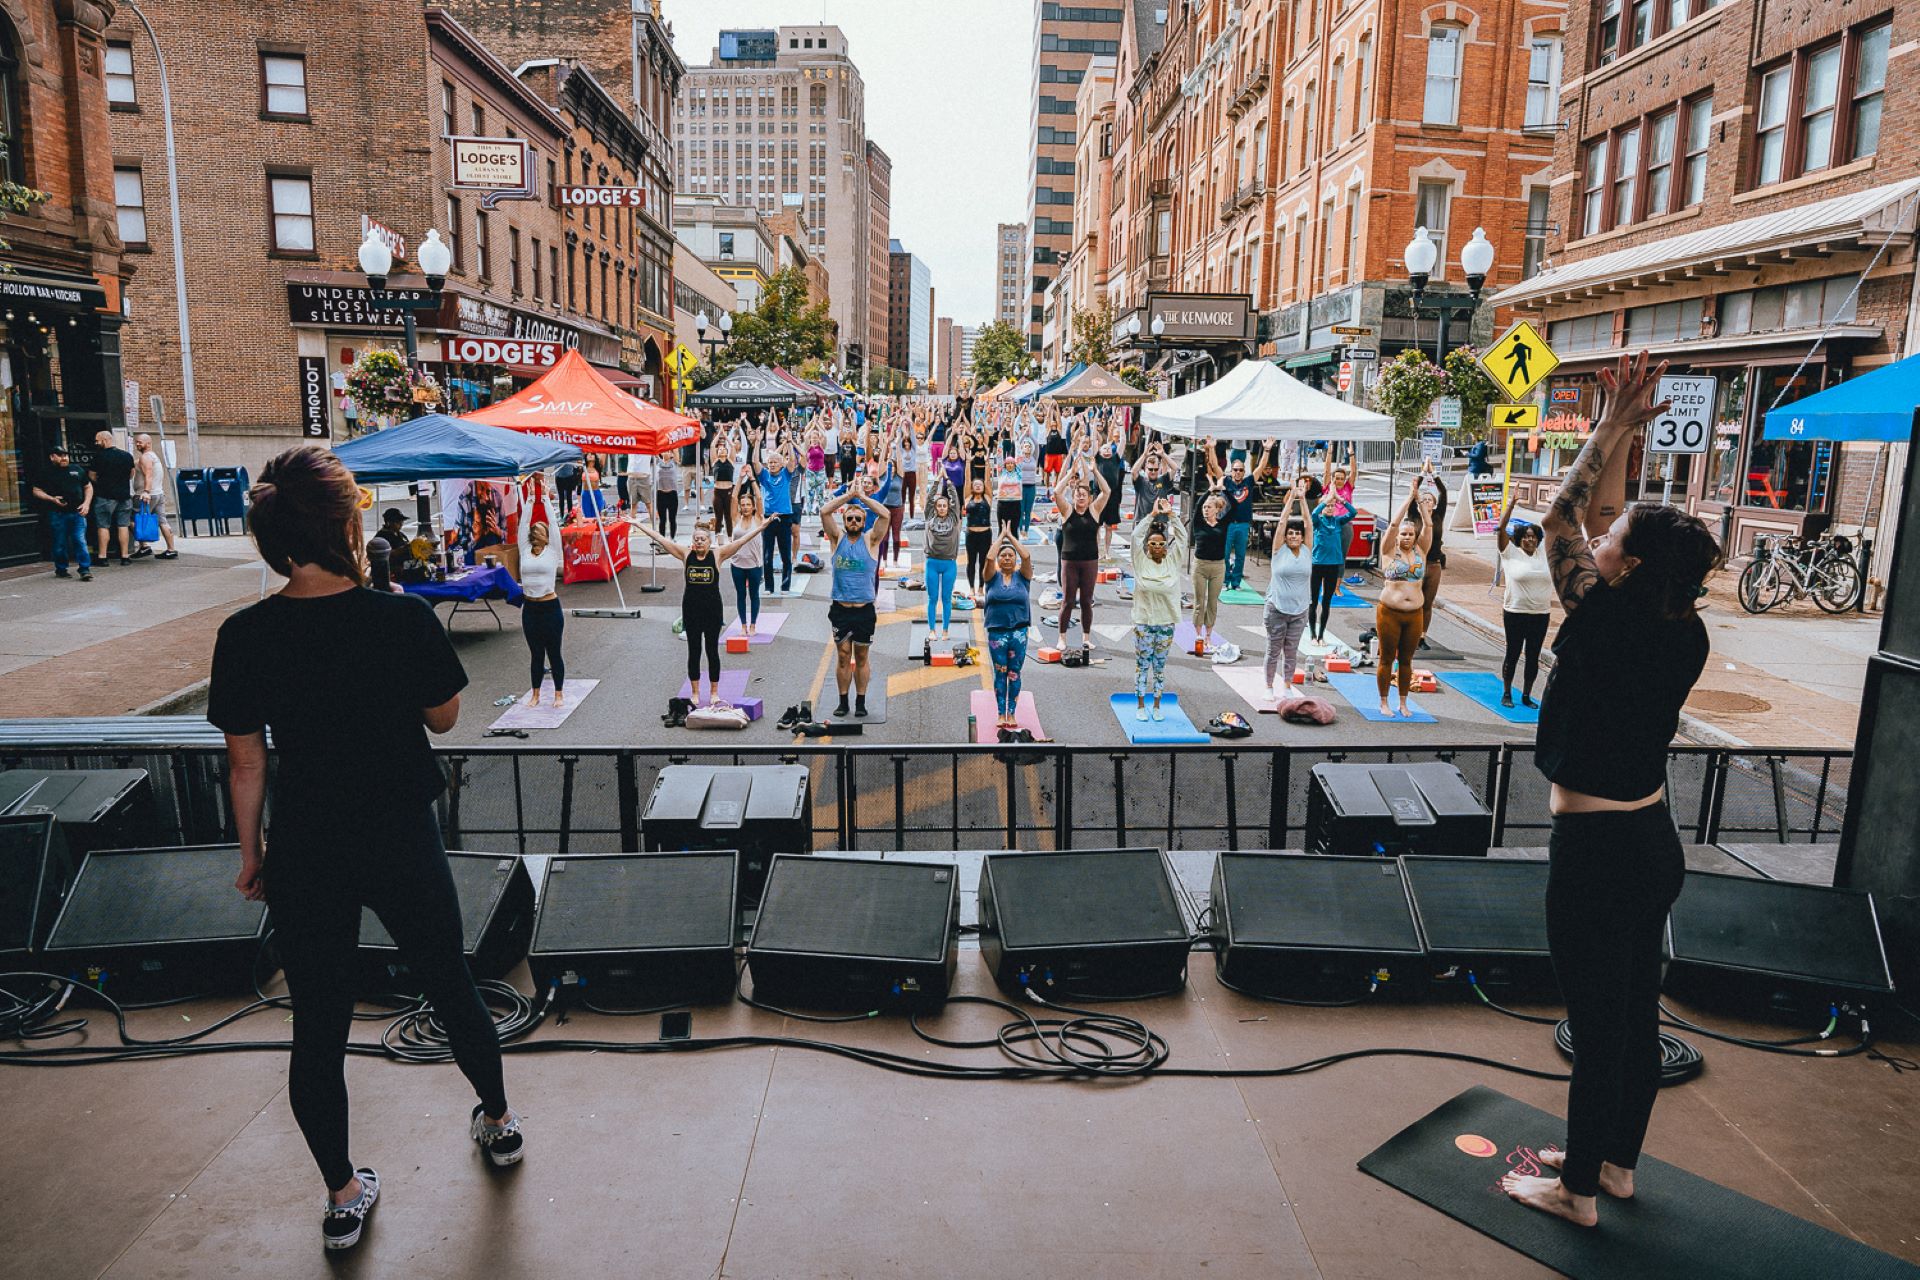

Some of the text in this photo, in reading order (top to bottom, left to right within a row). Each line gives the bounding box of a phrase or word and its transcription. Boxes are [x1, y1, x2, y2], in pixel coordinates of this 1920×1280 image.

[708, 75, 757, 86] SAVINGS
[766, 74, 798, 86] BANK
[460, 152, 518, 166] LODGE'S
[561, 187, 641, 206] LODGE'S
[3, 282, 36, 297] HOLLOW
[1162, 310, 1235, 326] THE KENMORE
[525, 319, 558, 342] LODGE
[449, 339, 556, 367] LODGE'S
[728, 381, 761, 389] EQX
[1672, 381, 1702, 392] CITY
[1554, 390, 1577, 400] OPEN
[1664, 394, 1706, 405] SPEED
[544, 401, 593, 413] MVP
[1666, 407, 1700, 417] LIMIT
[1539, 413, 1590, 433] Healthy
[1789, 418, 1805, 435] 84
[1656, 419, 1704, 448] 30
[581, 553, 600, 562] MVP
